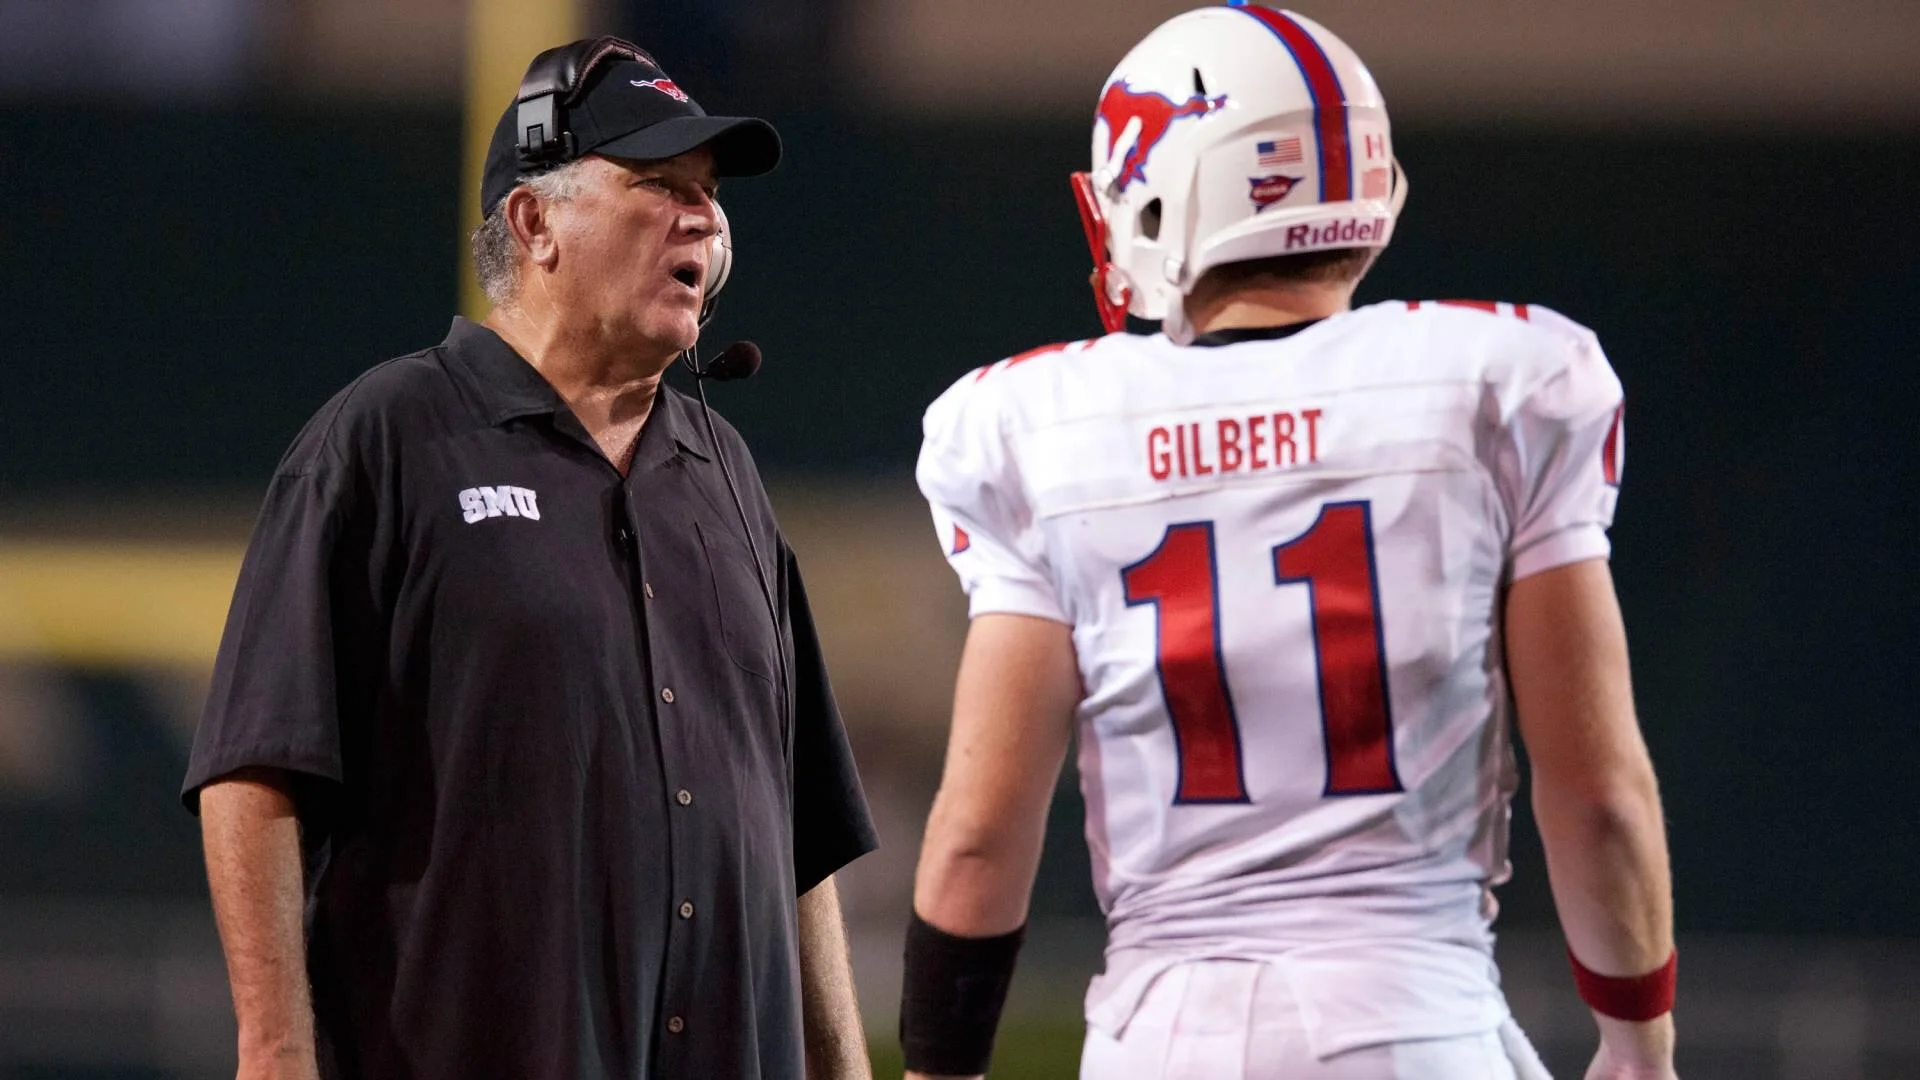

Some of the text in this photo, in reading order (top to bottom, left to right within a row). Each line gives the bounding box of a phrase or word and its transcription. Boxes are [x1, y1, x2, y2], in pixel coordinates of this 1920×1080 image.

[1284, 217, 1386, 250] Riddell
[1147, 408, 1322, 481] GILBERT
[458, 485, 541, 524] SMU
[1120, 500, 1406, 806] 11
